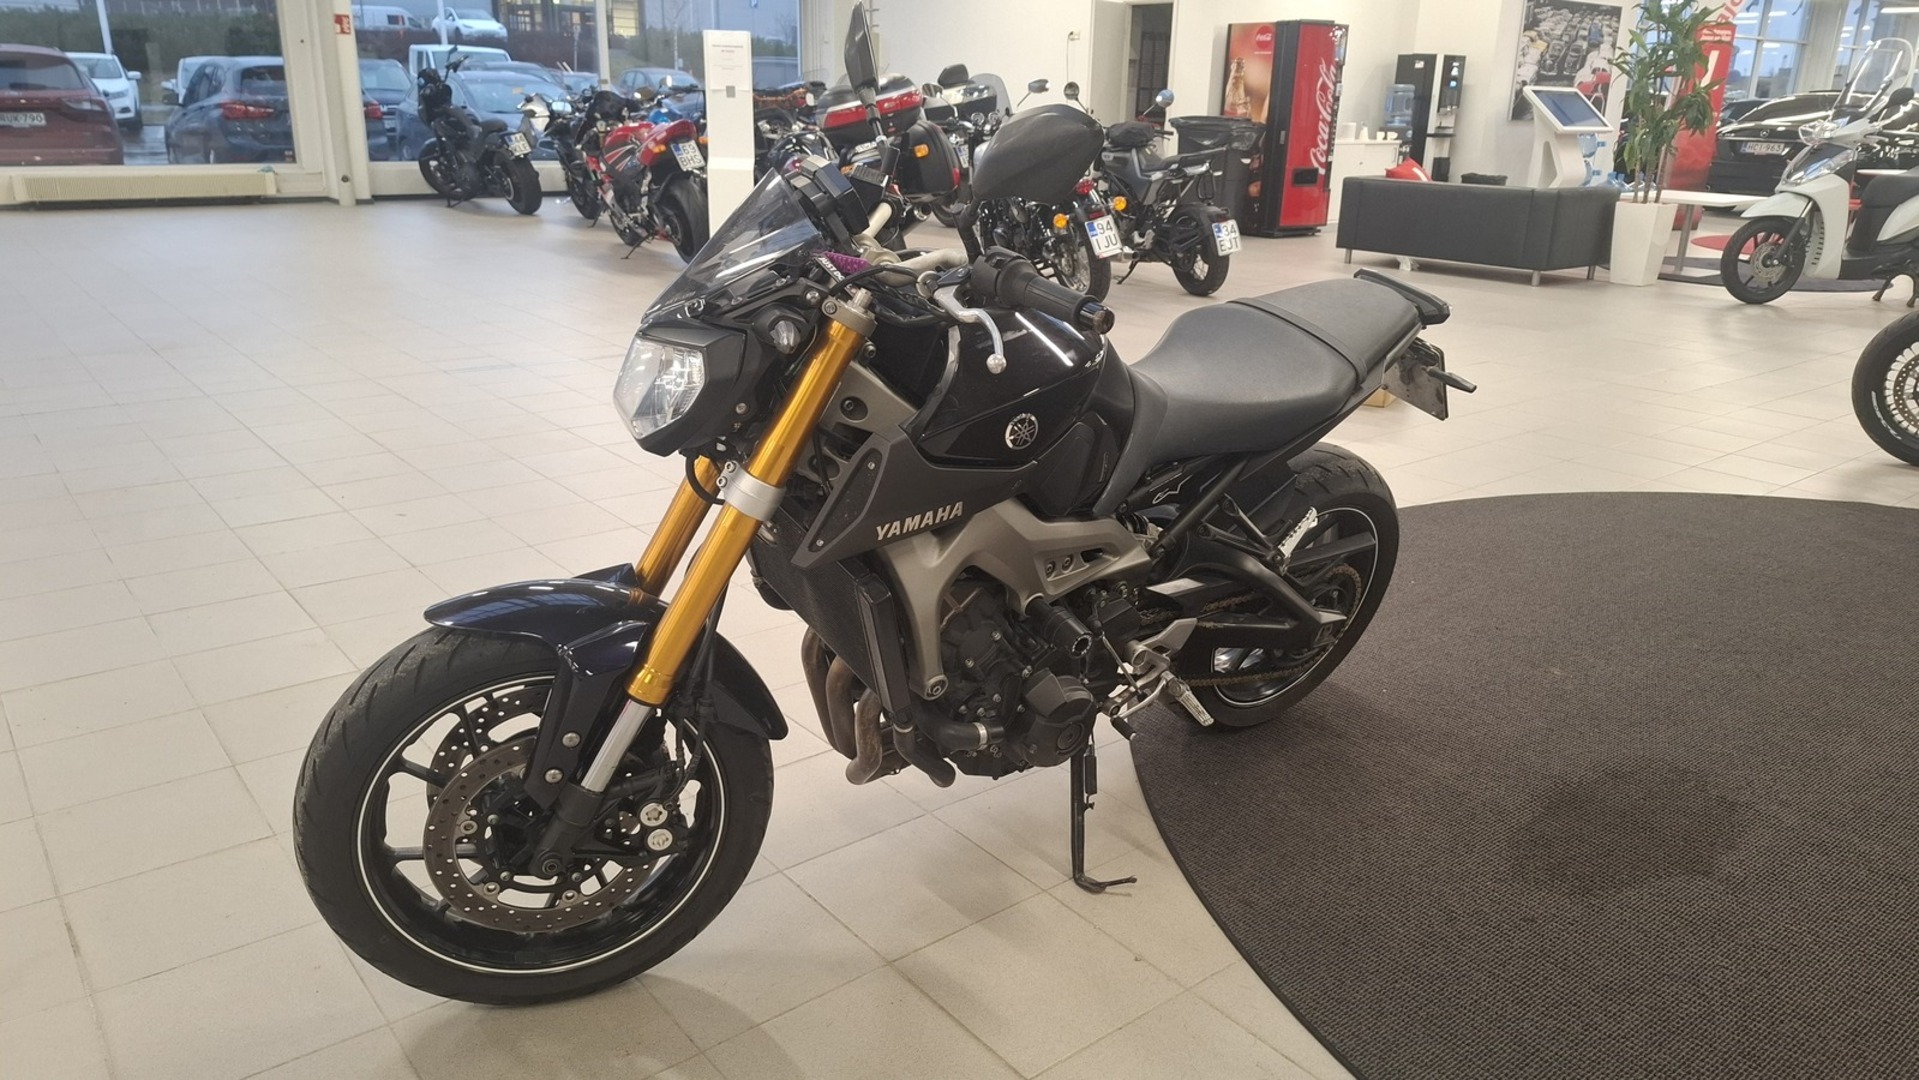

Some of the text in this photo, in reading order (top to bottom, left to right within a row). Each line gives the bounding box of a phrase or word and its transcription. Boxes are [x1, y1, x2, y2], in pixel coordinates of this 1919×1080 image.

[1310, 57, 1337, 175] Coca-Cola
[682, 144, 697, 155] 69
[679, 154, 702, 167] BHS
[1096, 220, 1113, 235] 94
[1222, 224, 1237, 237] 34
[1219, 236, 1239, 252] EJT
[876, 501, 963, 540] YAMAHA
